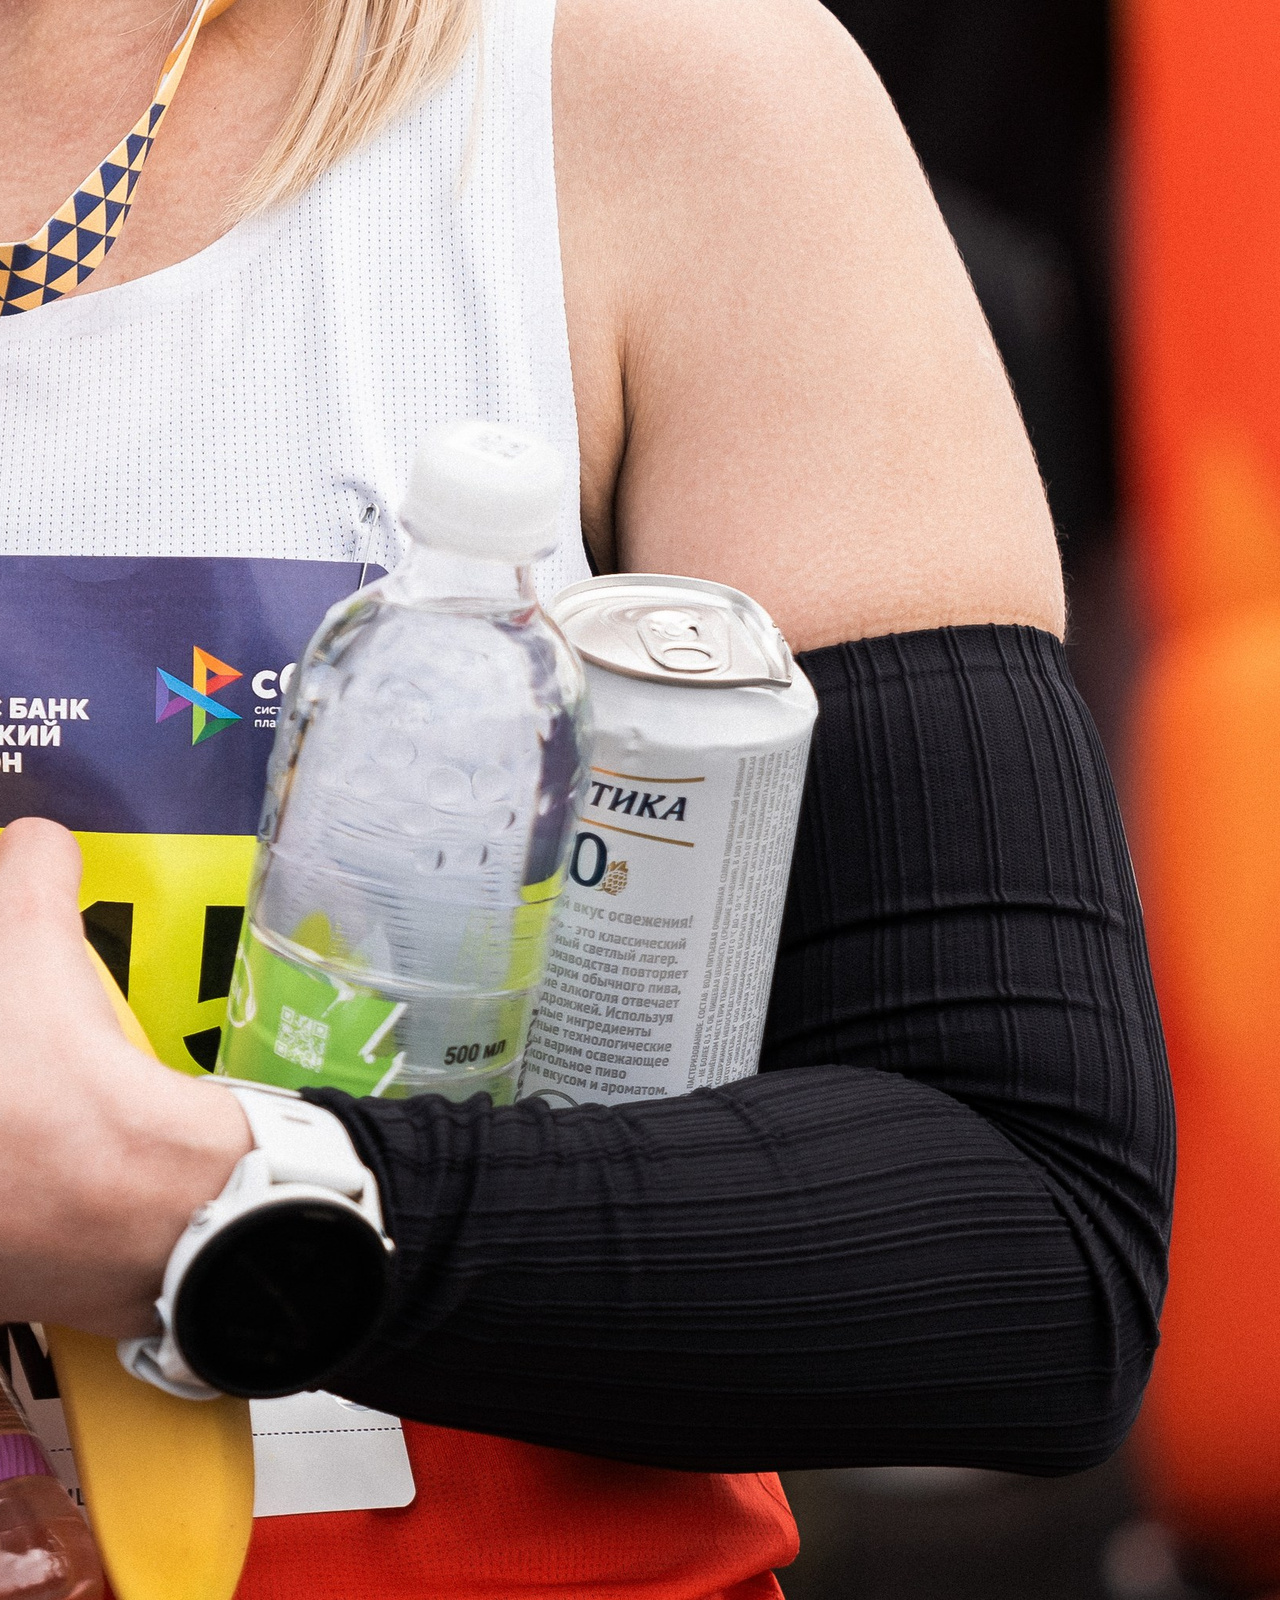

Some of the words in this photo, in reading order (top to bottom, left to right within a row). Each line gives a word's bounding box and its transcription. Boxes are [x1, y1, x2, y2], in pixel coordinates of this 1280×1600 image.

[9, 698, 90, 721] БАНК
[254, 719, 276, 728] пла
[574, 902, 604, 920] вкус
[608, 910, 694, 929] освежения!
[575, 926, 596, 939] это
[598, 931, 687, 950] классический
[583, 943, 636, 962] светлый
[639, 953, 679, 967] лагер.
[581, 973, 646, 993] обычного
[648, 984, 682, 995] пива,
[621, 966, 689, 982] повторяет
[561, 982, 619, 1004] алкоголя
[621, 996, 680, 1009] отвечает
[540, 992, 602, 1016] дрожжей.
[605, 1005, 674, 1026] Используя
[566, 1014, 652, 1038] ингредиенты
[443, 1043, 480, 1065] 500
[482, 1039, 506, 1060] мл
[562, 1028, 673, 1053] технологические
[544, 1038, 583, 1058] варим
[585, 1050, 670, 1069] освежающее
[706, 1041, 719, 1087] АТЕМНЁННОМ
[543, 1068, 587, 1088] вкусом
[601, 1082, 668, 1097] ароматом.
[595, 1066, 627, 1080] пиво
